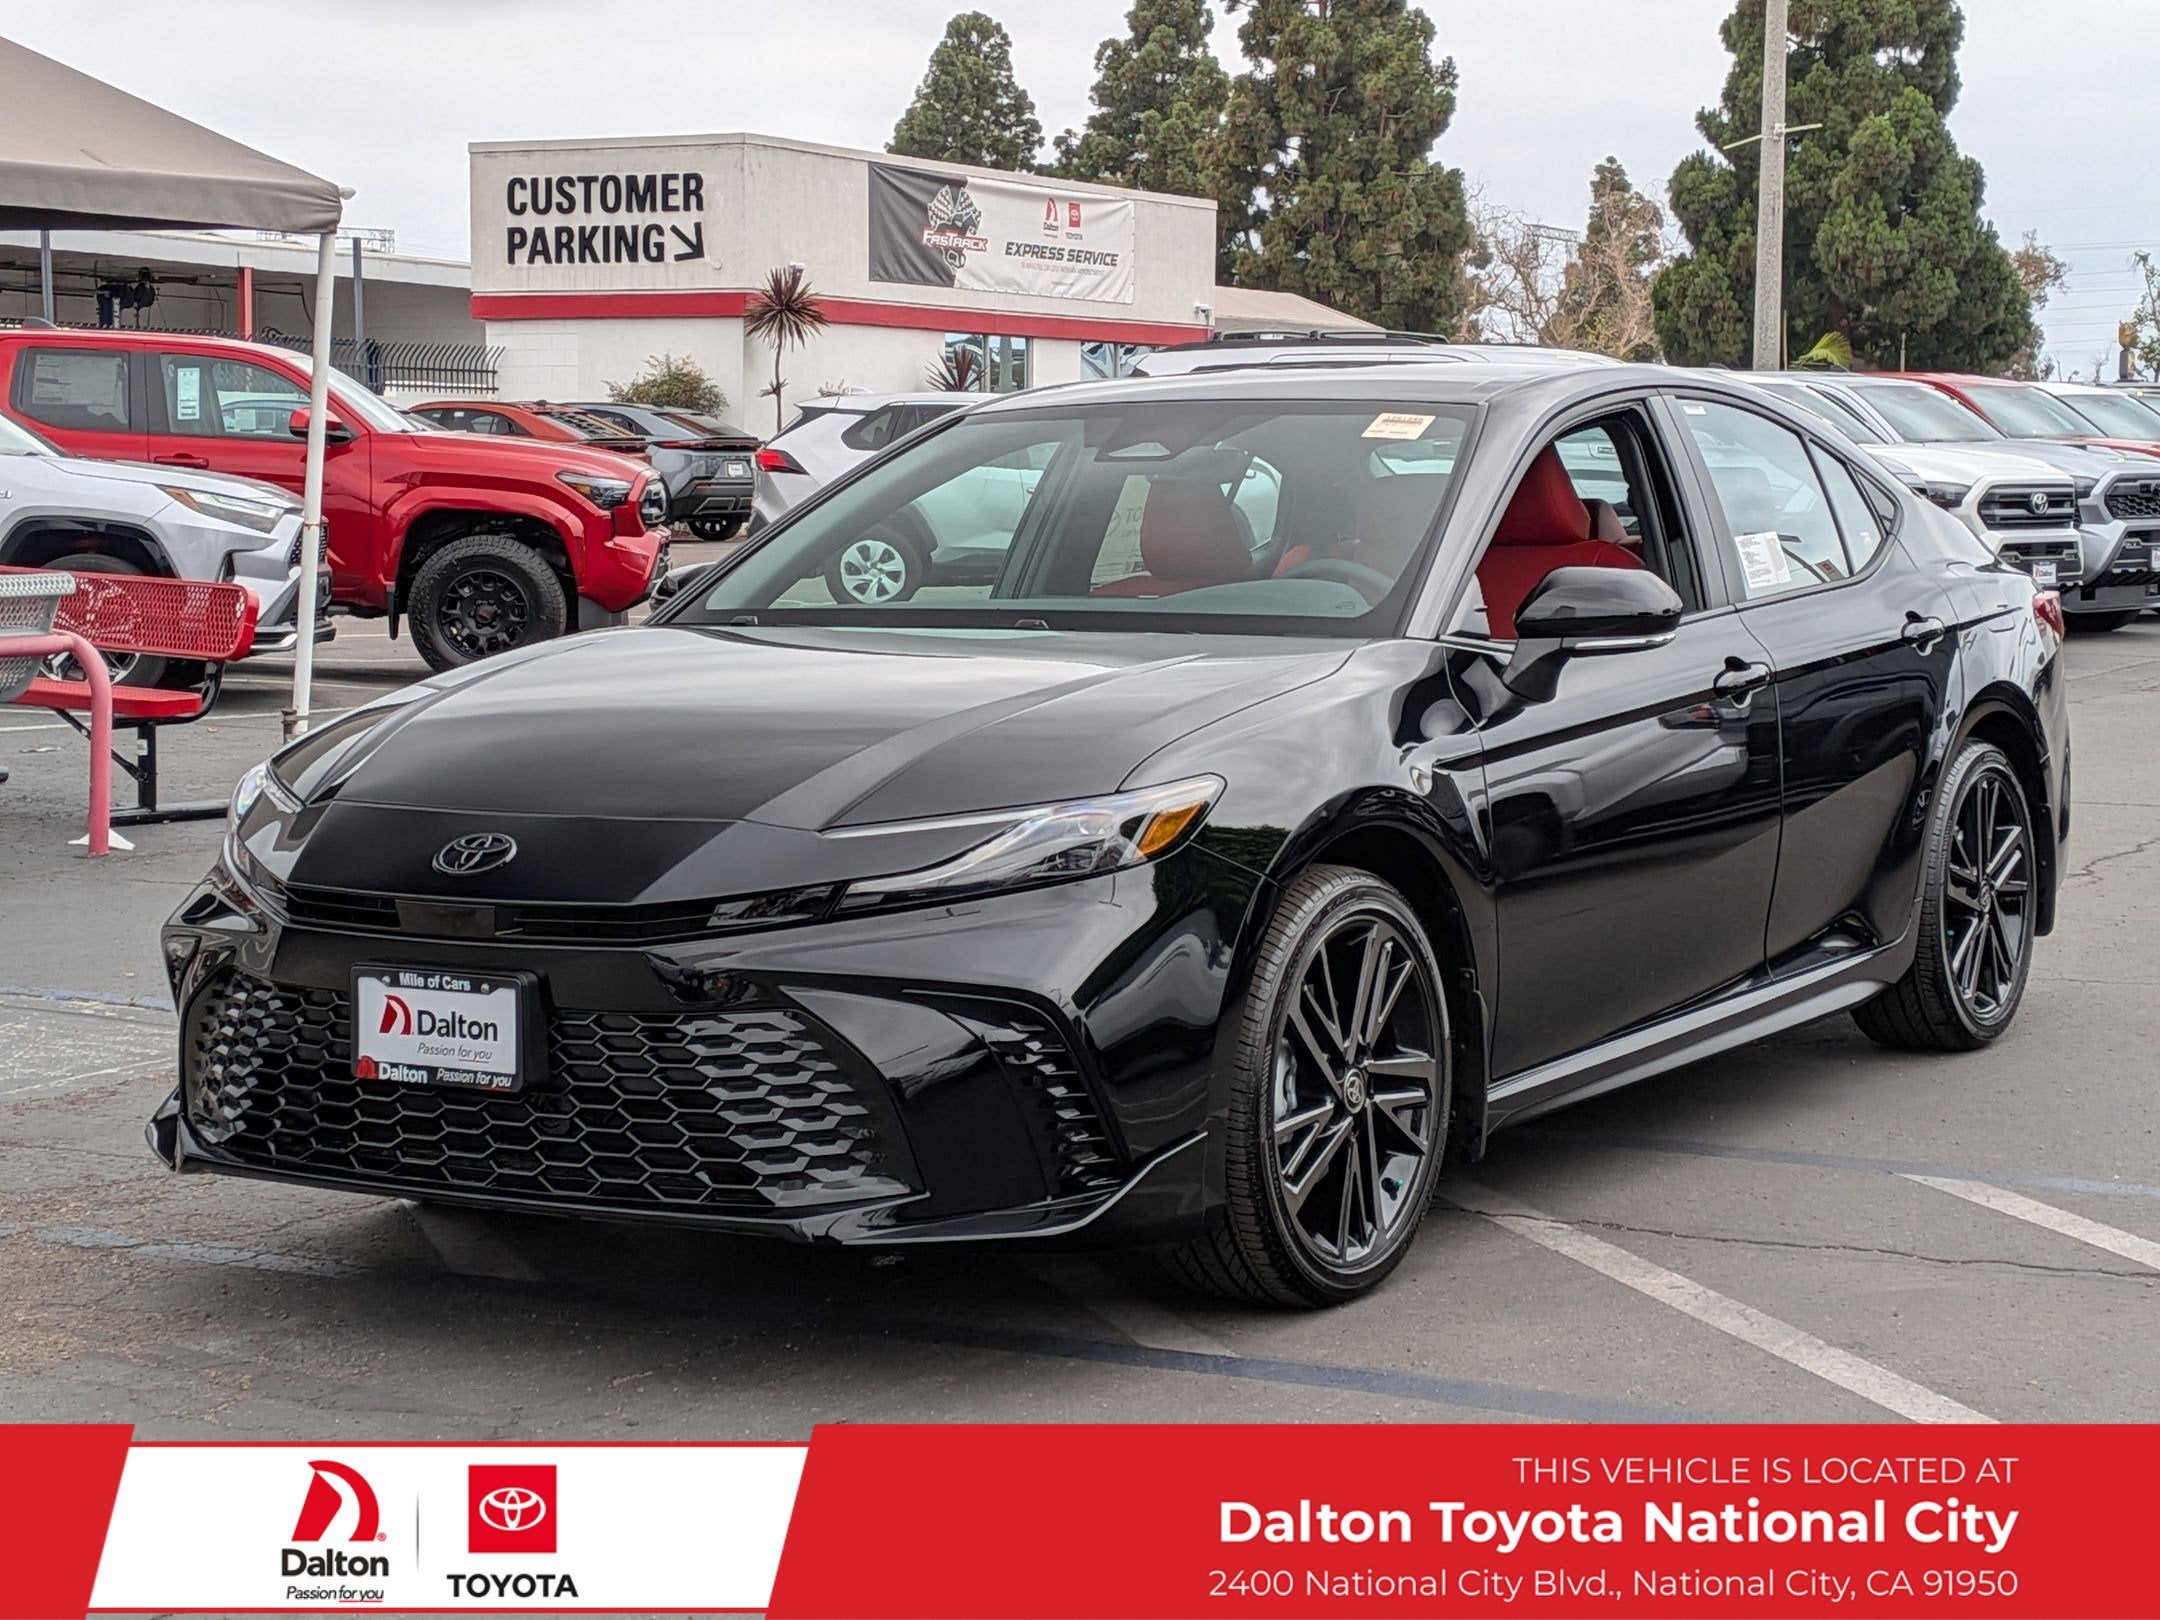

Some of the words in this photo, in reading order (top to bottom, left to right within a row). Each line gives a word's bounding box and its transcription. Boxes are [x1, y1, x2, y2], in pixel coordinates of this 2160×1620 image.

[507, 172, 704, 216] CUSTOMER
[507, 223, 665, 265] PARKING
[1005, 241, 1065, 261] EXPRESS
[1066, 248, 1119, 267] SERVICE
[399, 972, 424, 987] Mile
[427, 975, 440, 988] of
[442, 976, 471, 991] Cars
[417, 1009, 498, 1041] Dalton
[417, 1042, 456, 1056] Passion
[457, 1045, 472, 1058] for
[473, 1050, 492, 1060] you
[378, 1063, 428, 1084] Dalton
[436, 1068, 474, 1083] Passion
[475, 1072, 491, 1085] for
[491, 1076, 512, 1088] you
